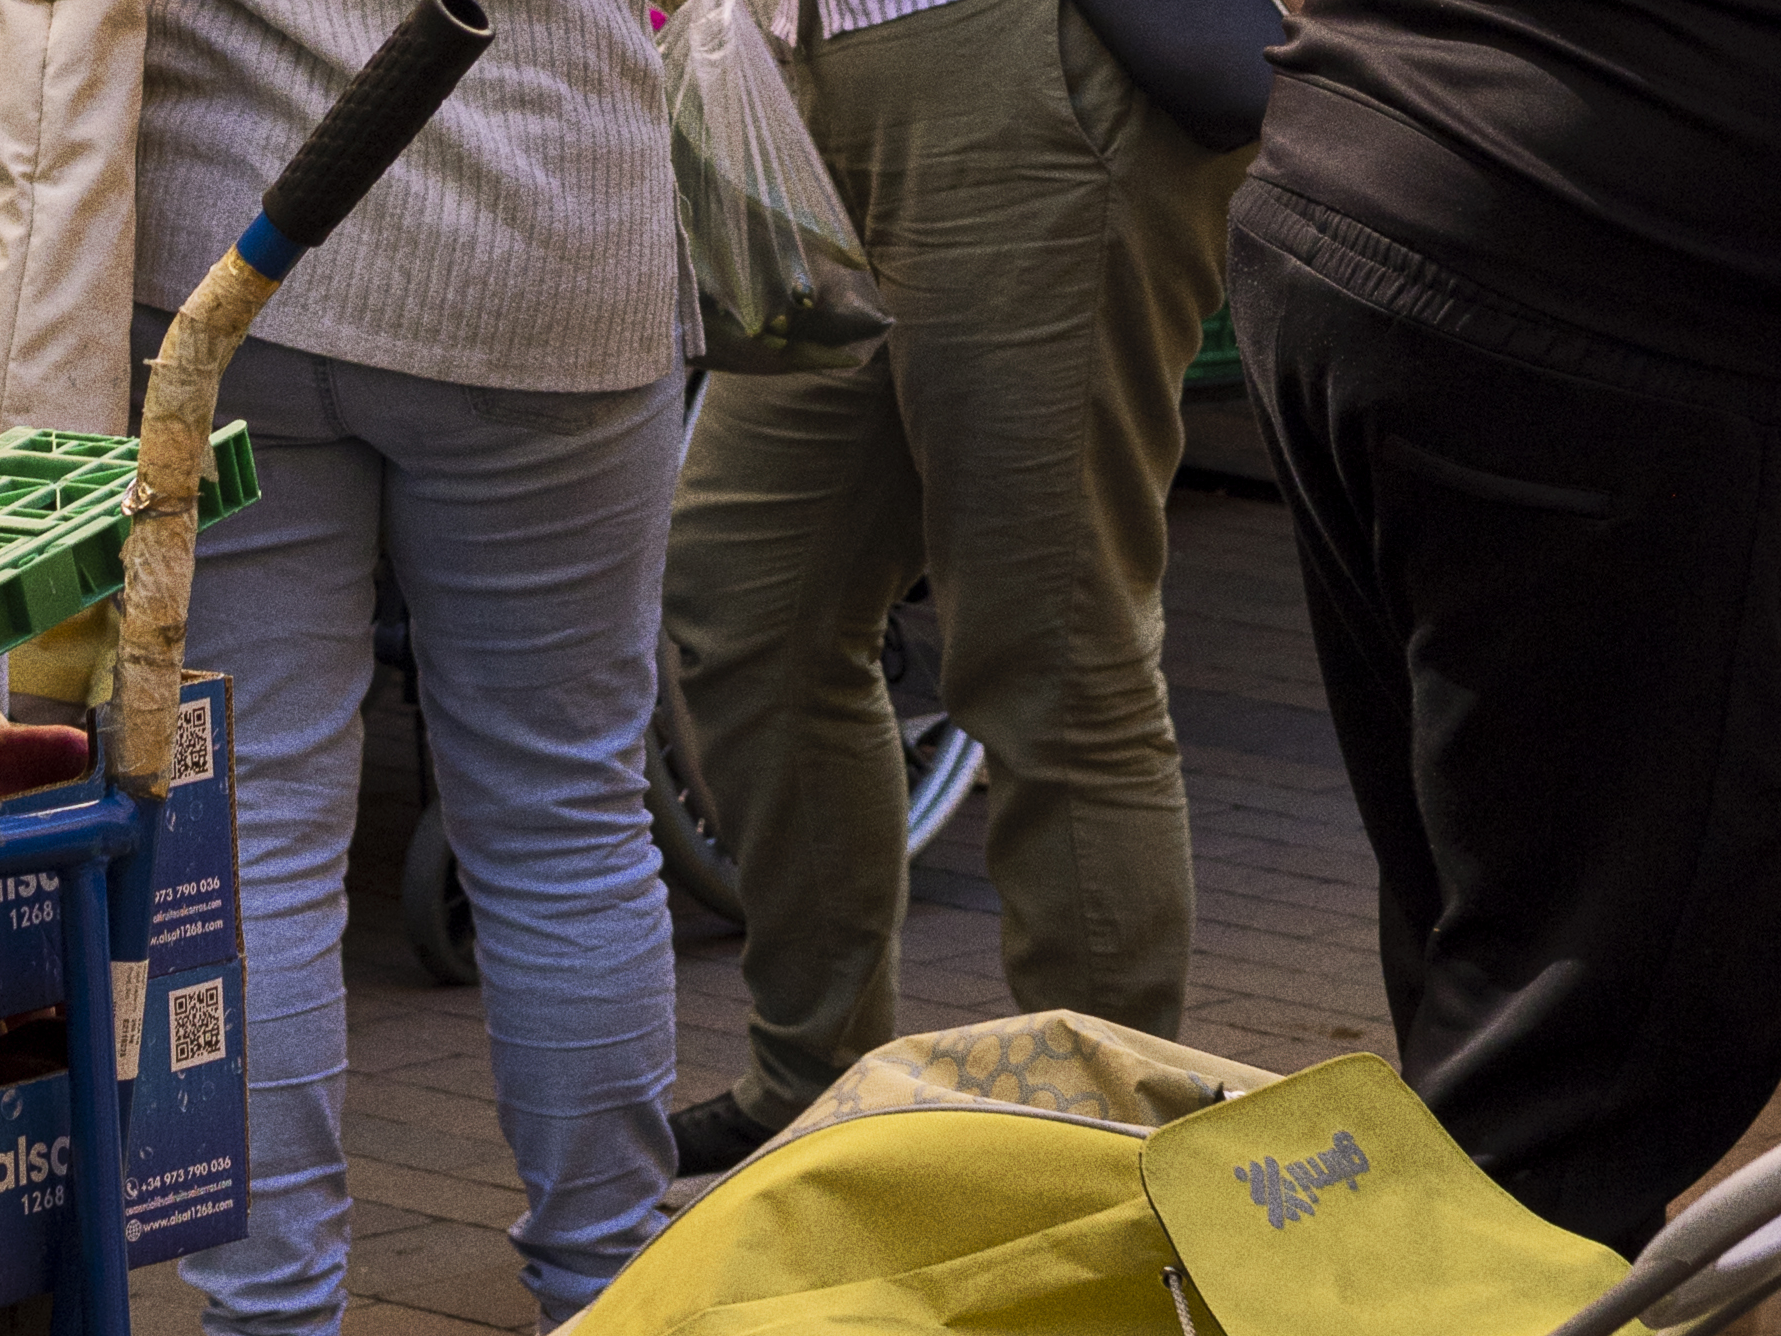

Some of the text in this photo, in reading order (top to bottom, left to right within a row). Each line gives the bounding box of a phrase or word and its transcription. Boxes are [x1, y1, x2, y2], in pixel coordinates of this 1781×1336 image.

[176, 882, 198, 899] 790
[199, 875, 221, 894] 036
[9, 900, 55, 932] 1268
[164, 1168, 185, 1186] 973
[187, 1161, 208, 1180] 790
[210, 1154, 232, 1173] 036
[21, 1184, 66, 1217] 1268
